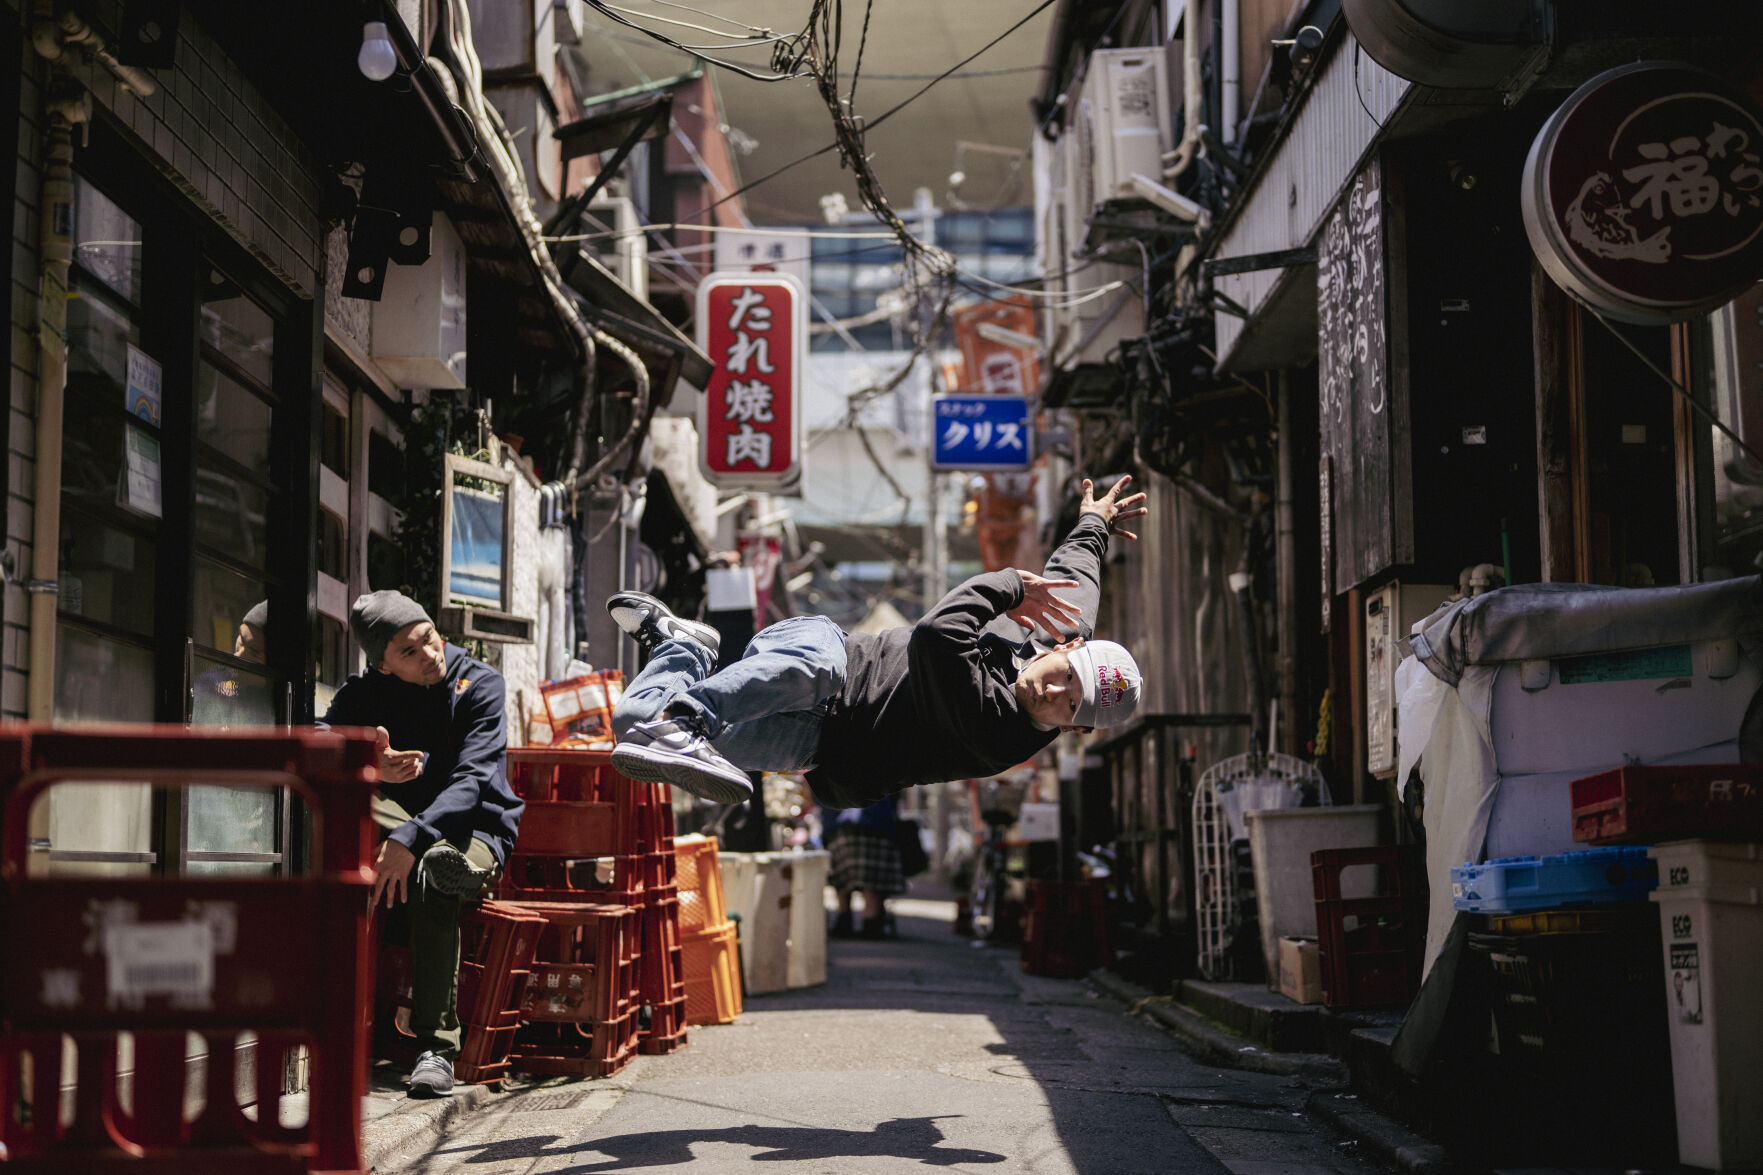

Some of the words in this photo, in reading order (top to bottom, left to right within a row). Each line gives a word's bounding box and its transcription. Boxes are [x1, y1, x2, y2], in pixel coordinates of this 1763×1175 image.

[1622, 136, 1720, 220] 福
[725, 286, 776, 469] たれ焼肉
[943, 420, 1024, 451] クリス
[1098, 665, 1111, 686] Red
[1101, 687, 1111, 708] Bull
[1670, 866, 1689, 886] ECO
[1672, 914, 1692, 935] ECO
